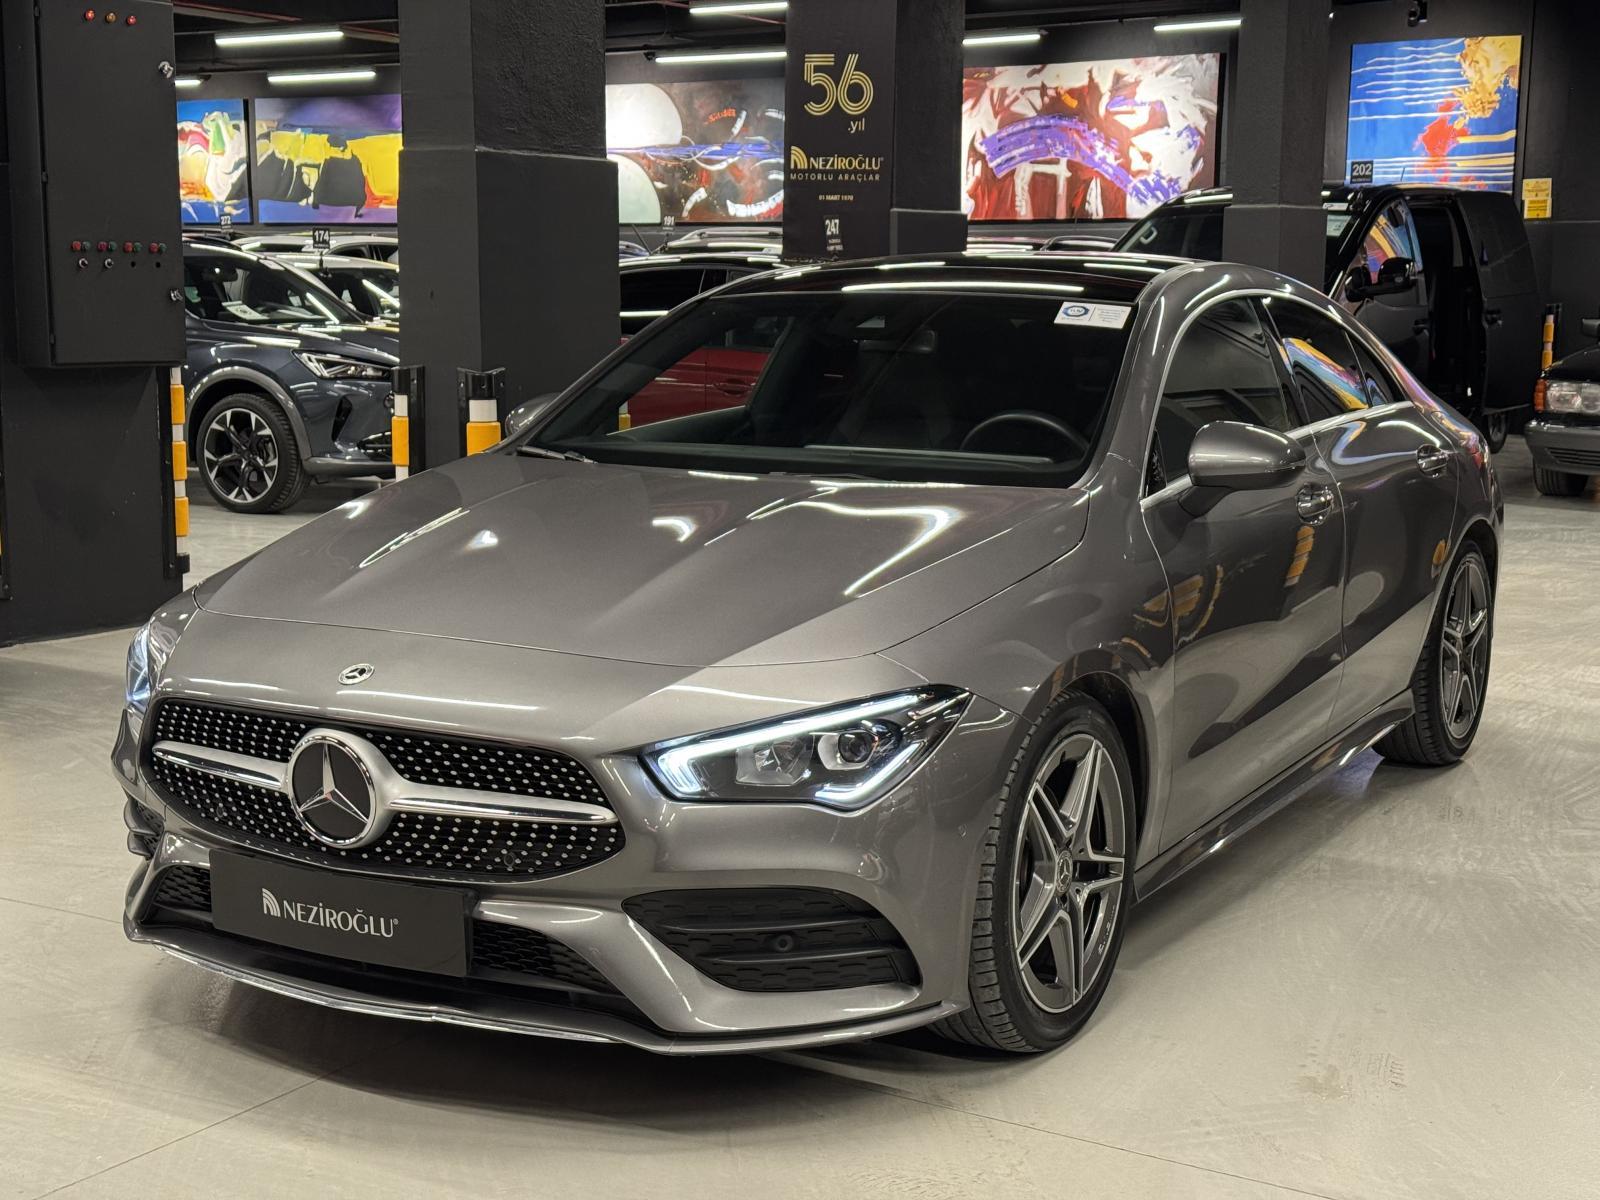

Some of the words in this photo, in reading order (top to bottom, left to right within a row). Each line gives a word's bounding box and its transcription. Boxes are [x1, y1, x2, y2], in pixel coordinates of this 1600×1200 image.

[804, 53, 874, 116] 56
[1352, 163, 1372, 176] 202
[790, 173, 834, 181] MOTORLU
[838, 173, 881, 183] ARAÇLAR
[825, 218, 840, 235] 247
[314, 230, 329, 242] 174
